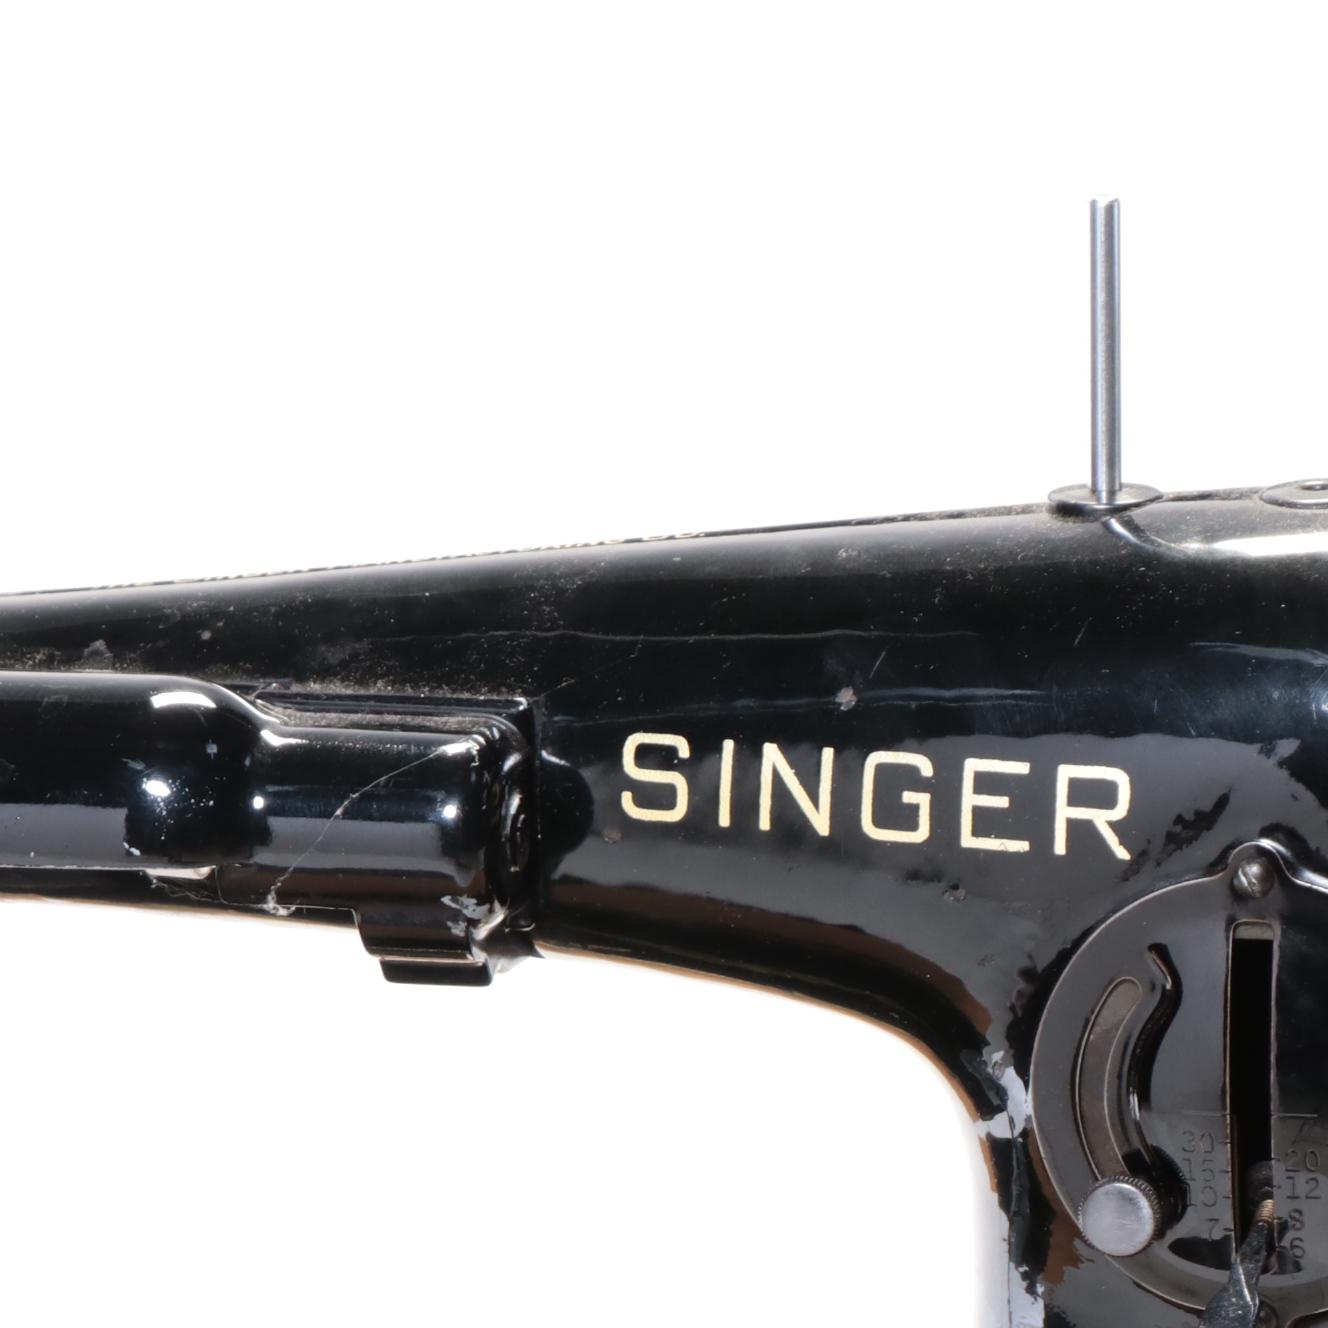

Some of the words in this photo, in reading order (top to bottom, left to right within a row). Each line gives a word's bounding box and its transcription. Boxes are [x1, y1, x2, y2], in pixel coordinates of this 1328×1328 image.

[621, 732, 1132, 861] SINGER
[1181, 1129, 1216, 1154] 30
[1181, 1157, 1217, 1182] 15
[1285, 1149, 1321, 1173] 20
[1182, 1181, 1218, 1208] 10
[1285, 1176, 1321, 1200] 12
[1205, 1218, 1221, 1242] 7
[1288, 1208, 1306, 1232] 8
[1289, 1236, 1307, 1260] 6
